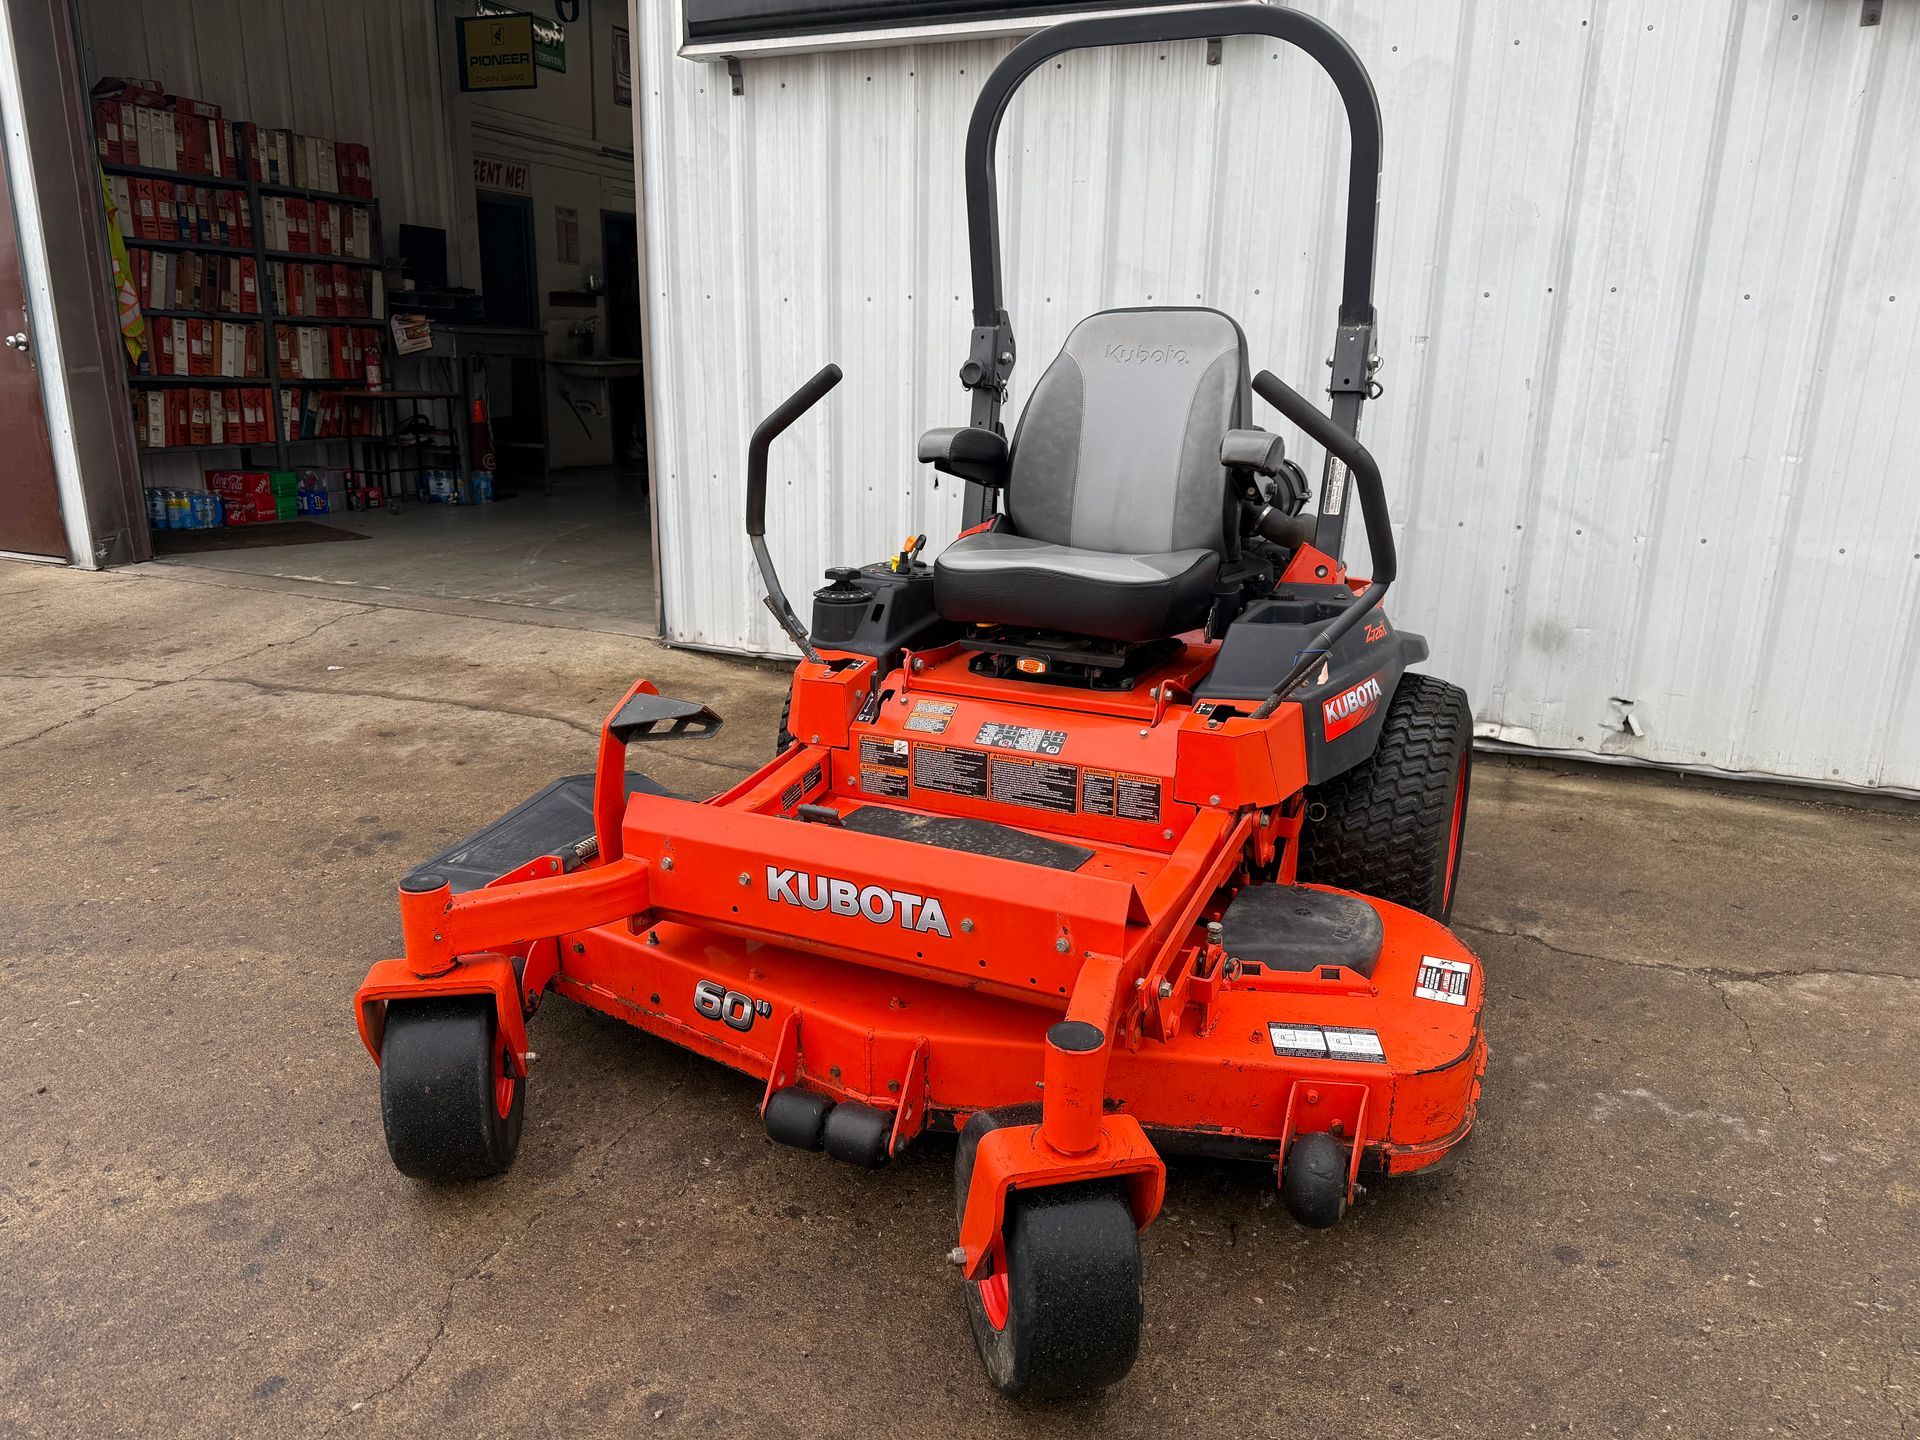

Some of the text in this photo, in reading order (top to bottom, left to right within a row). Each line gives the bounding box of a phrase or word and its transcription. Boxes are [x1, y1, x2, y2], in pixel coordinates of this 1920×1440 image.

[470, 53, 530, 67] PIONEER
[505, 165, 526, 190] ME!
[1104, 344, 1188, 364] Kubota
[1324, 677, 1383, 725] KUBOTA
[998, 755, 1031, 765] ADVERTENCIA
[1124, 774, 1160, 783] ADVERTENCIA
[766, 865, 952, 938] KUBOTA
[694, 979, 773, 1032] 60"
